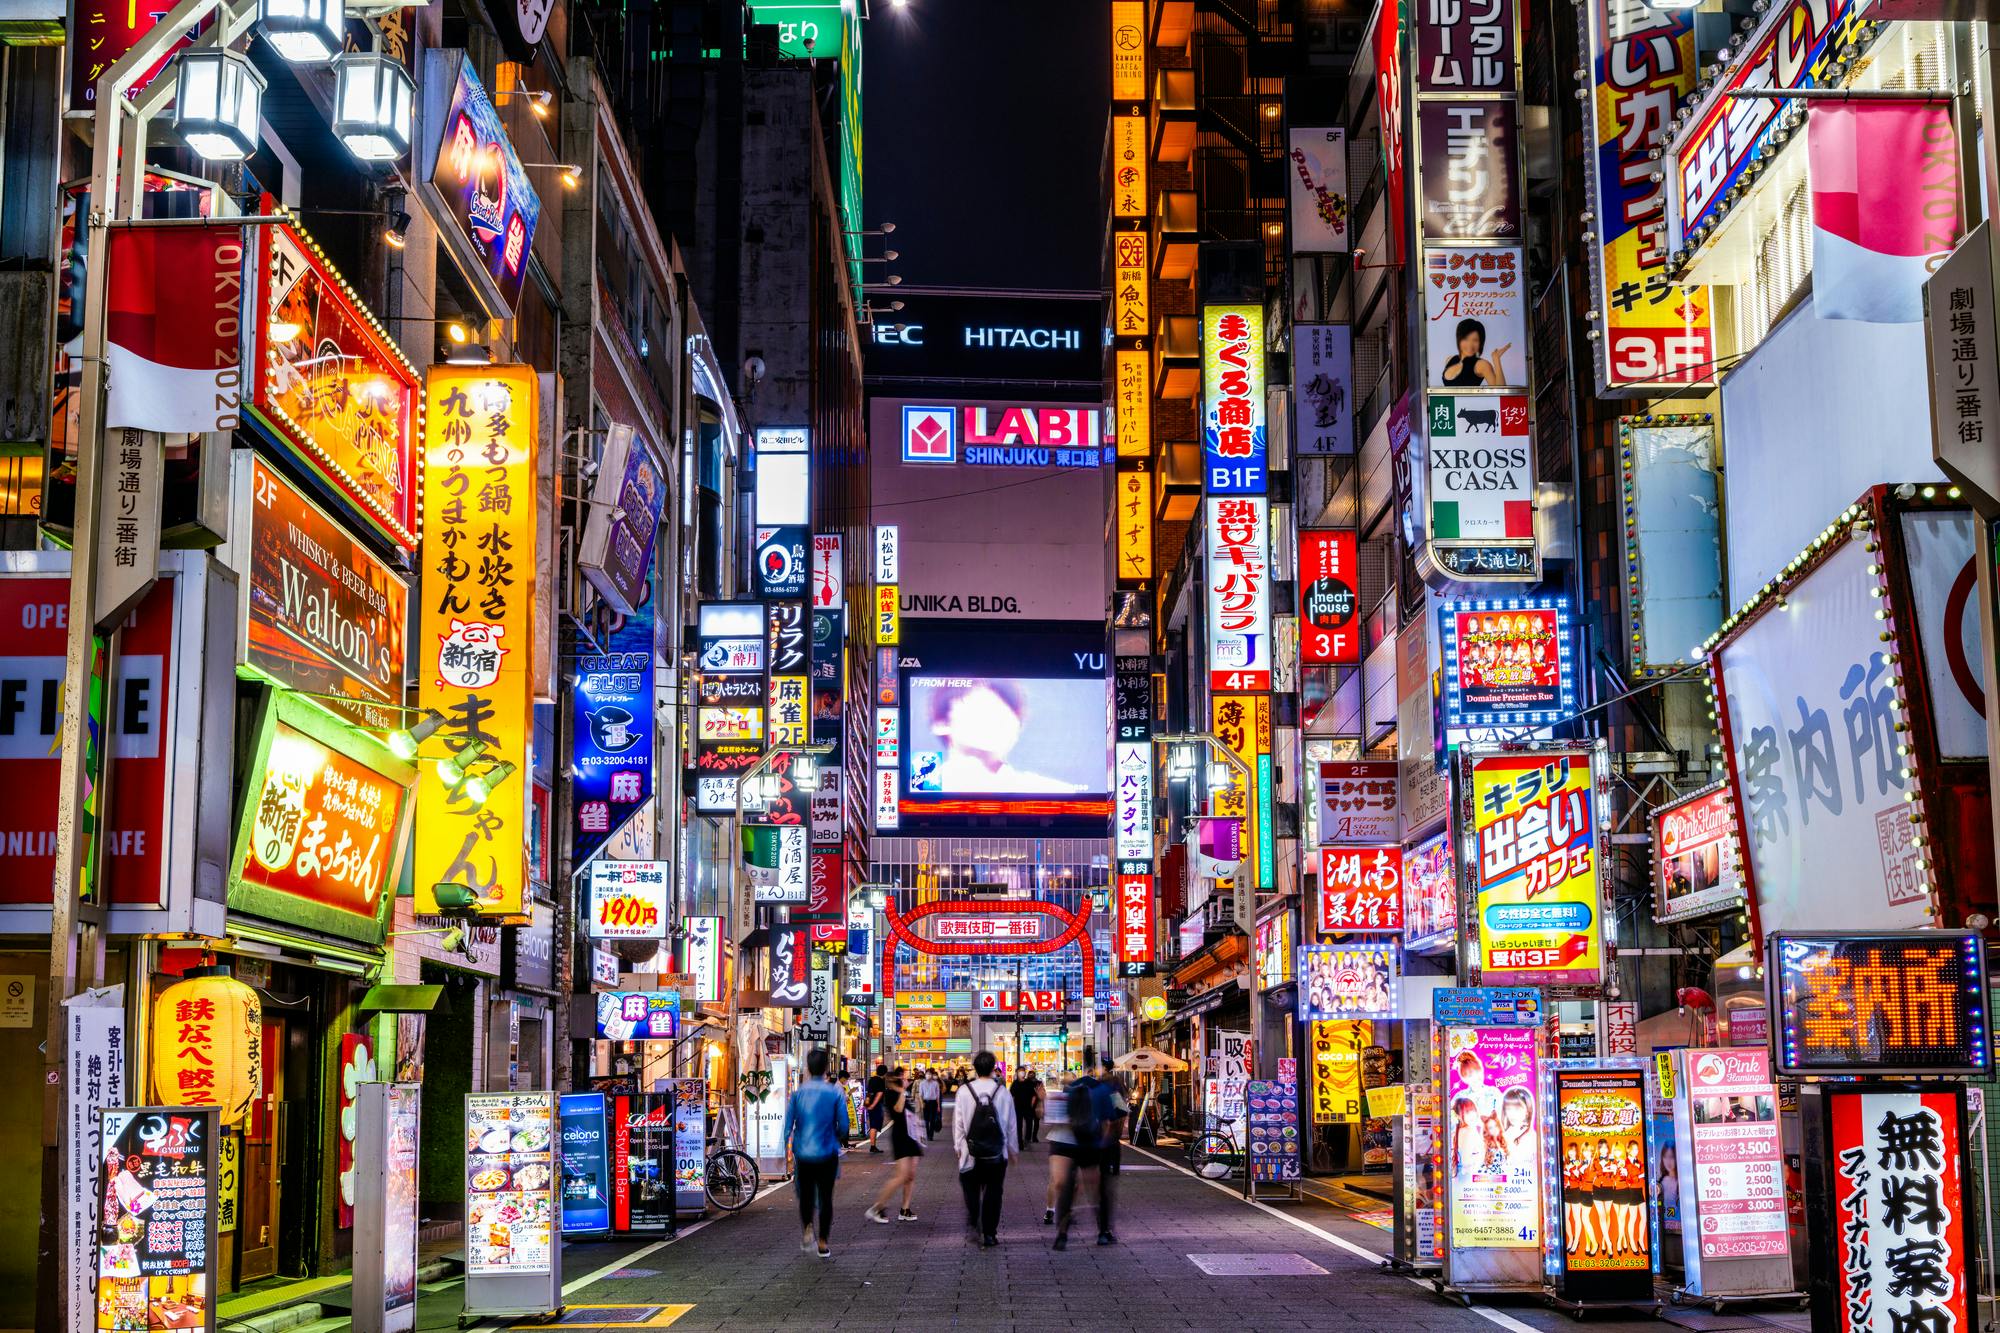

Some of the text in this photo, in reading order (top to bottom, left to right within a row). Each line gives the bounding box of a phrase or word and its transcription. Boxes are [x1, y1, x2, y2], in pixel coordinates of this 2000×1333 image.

[1115, 54, 1143, 62] kawara
[1115, 70, 1143, 79] DINING
[1131, 105, 1140, 116] 8
[1326, 131, 1342, 142] 5F
[1133, 220, 1141, 232] 7
[1448, 252, 1516, 271] タイ古式
[1121, 270, 1143, 282] 新橋
[1428, 271, 1517, 289] マッサージ
[1119, 284, 1145, 331] 魚金
[1462, 307, 1511, 318] Relax
[964, 326, 1080, 349] HITACHI
[1135, 339, 1143, 350] 6
[1614, 334, 1706, 380] 3F
[1949, 286, 1984, 444] 劇場通り一番街
[214, 345, 241, 431] 2020
[1218, 313, 1254, 459] まぐろ商店
[1121, 361, 1138, 445] ちびすけバル
[1433, 404, 1451, 421] 肉
[1501, 405, 1527, 417] イタリ
[964, 406, 1100, 447] LABI
[1431, 420, 1454, 431] バル
[1504, 414, 1525, 426] アン
[1312, 435, 1338, 453] 4F
[964, 446, 1100, 468] SHINJUKU 東口館
[1136, 460, 1145, 471] 5
[1431, 448, 1526, 471] XROSS
[1211, 466, 1261, 489] B1F
[1444, 469, 1519, 491] CASA
[115, 428, 143, 567] 劇場通り一番街
[256, 472, 278, 510] 2F
[437, 386, 475, 616] 九州のうまかもん
[1463, 518, 1500, 527] クロスカーサ
[759, 531, 772, 541] 4F
[1125, 495, 1146, 577] すずや
[881, 528, 894, 580] 小松ビル
[1443, 552, 1533, 571] 第一大滝ビル
[1213, 499, 1265, 631] 熟女キャバクラ
[1318, 540, 1328, 591] 肉ダイニング
[341, 565, 367, 603] BEER
[368, 585, 388, 617] BAR
[1138, 582, 1146, 592] 4
[1314, 579, 1355, 605] meat
[967, 596, 1022, 614] BLDG.
[1309, 596, 1350, 625] house
[279, 557, 391, 685] Walton's
[779, 605, 805, 671] リラク
[881, 634, 893, 643] 6F
[1315, 634, 1346, 657] 3F
[443, 642, 499, 672] 新宿
[1216, 644, 1242, 656] mrs
[581, 651, 649, 672] GREAT
[1116, 658, 1149, 672] 小料理
[461, 671, 480, 686] の
[587, 673, 642, 694] BLUE
[918, 679, 973, 688] FROM HERE
[1225, 672, 1256, 690] 4F
[779, 678, 803, 724] 麻雀
[1116, 676, 1127, 721] いろは
[1138, 675, 1149, 721] あづま
[1466, 692, 1554, 703] Domaine Premiere Rue
[705, 720, 750, 731] クアトロ
[1121, 726, 1146, 738] 3F
[1258, 701, 1270, 748] 炭火串焼
[778, 727, 804, 746] 2F
[1742, 651, 1906, 849] 案内所
[590, 755, 648, 765] 03-3200-4181
[1351, 765, 1369, 776] 2F
[883, 771, 893, 804] お好み焼
[1341, 780, 1397, 796] タイ古式
[1484, 757, 1570, 816] キラリ
[1120, 774, 1139, 837] バンタイ
[1325, 795, 1397, 812] マッサージ
[1480, 785, 1589, 881] 出会い
[1678, 809, 1700, 841] Pink
[296, 810, 381, 902] まっちゃん
[770, 831, 778, 867] TOKYO 2020
[784, 827, 804, 885] 居酒屋
[1128, 849, 1142, 857] 3F
[595, 870, 663, 884] 一軒め酒場
[1123, 863, 1148, 875] 焼肉
[1326, 849, 1400, 889] 湖南
[1526, 843, 1592, 898] カフェ
[787, 890, 807, 900] B1F
[600, 898, 659, 927] 190円
[1125, 880, 1148, 957] 安楽亭
[1327, 892, 1381, 927] 菜館
[939, 920, 1037, 936] 歌舞伎町一番街
[1492, 949, 1560, 967] 受付3F
[1127, 963, 1146, 974] 2F
[650, 999, 674, 1009] フリー
[1802, 947, 1958, 1047] 案内所
[176, 998, 217, 1107] 鉄なべ餃子
[1317, 1053, 1344, 1061] COCO
[1725, 1056, 1761, 1073] Pink
[1317, 1062, 1334, 1113] BAR
[1562, 1080, 1592, 1088] Domaine
[1592, 1079, 1623, 1087] Premiere
[1726, 1074, 1766, 1085] Flamingo
[511, 1095, 547, 1107] まっちゃん
[106, 1117, 122, 1136] 2F
[624, 1112, 673, 1128] Real
[1565, 1108, 1635, 1127] 飲み放題
[563, 1129, 600, 1141] celona
[1518, 1226, 1537, 1241] 4F
[1704, 1219, 1718, 1231] 5F
[1716, 1241, 1785, 1254] 03-6205-9796
